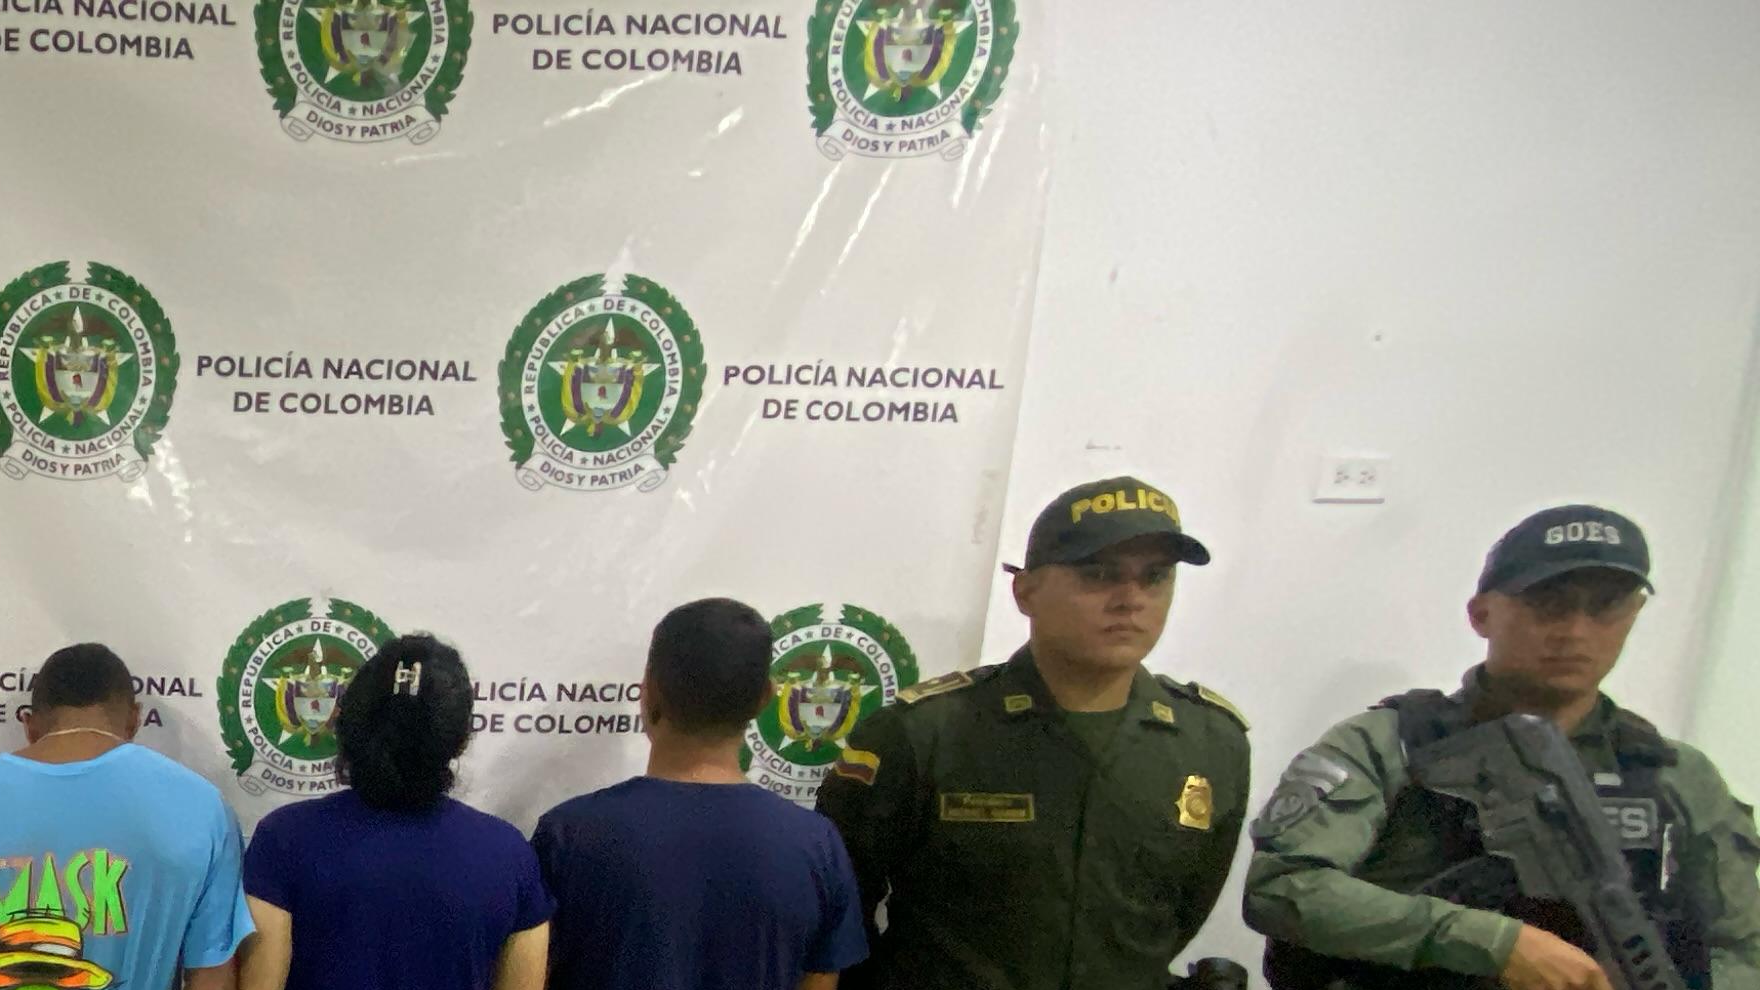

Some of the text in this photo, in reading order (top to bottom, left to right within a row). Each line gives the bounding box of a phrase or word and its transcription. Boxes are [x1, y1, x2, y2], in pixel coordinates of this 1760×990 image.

[74, 0, 236, 26] NACIONAL
[493, 8, 787, 38] POLICÍA NACIONAL
[30, 28, 194, 60] COLOMBIA
[532, 49, 742, 75] DE COLOMBIA
[362, 65, 437, 116] NACIONAL
[901, 79, 978, 132] NACIONAL
[306, 110, 344, 134] DIOS
[360, 115, 416, 137] PATRIA
[69, 287, 91, 299] DE
[108, 298, 153, 388] COLOMBIA
[604, 299, 626, 311] DE
[640, 310, 679, 398] COLOMBIA
[196, 351, 477, 382] POLICÍA NACIONAL
[723, 360, 1005, 390] POLICÍA NACIONAL
[233, 391, 435, 416] DE COLOMBIA
[762, 399, 958, 423] DE COLOMBIA
[75, 408, 145, 455] NACIONAL
[593, 417, 668, 466] NACIONAL
[22, 450, 56, 474] DIOS
[74, 453, 125, 475] PATRIA
[540, 461, 573, 484] DIOS
[590, 463, 645, 486] PATRIA
[1544, 521, 1620, 544] GOES
[310, 621, 331, 633] DE
[821, 627, 843, 638] DE
[474, 677, 547, 702] LICÍA
[470, 713, 643, 735] DE COLOMBI
[261, 769, 294, 789] DIOS
[758, 774, 791, 795] DIOS
